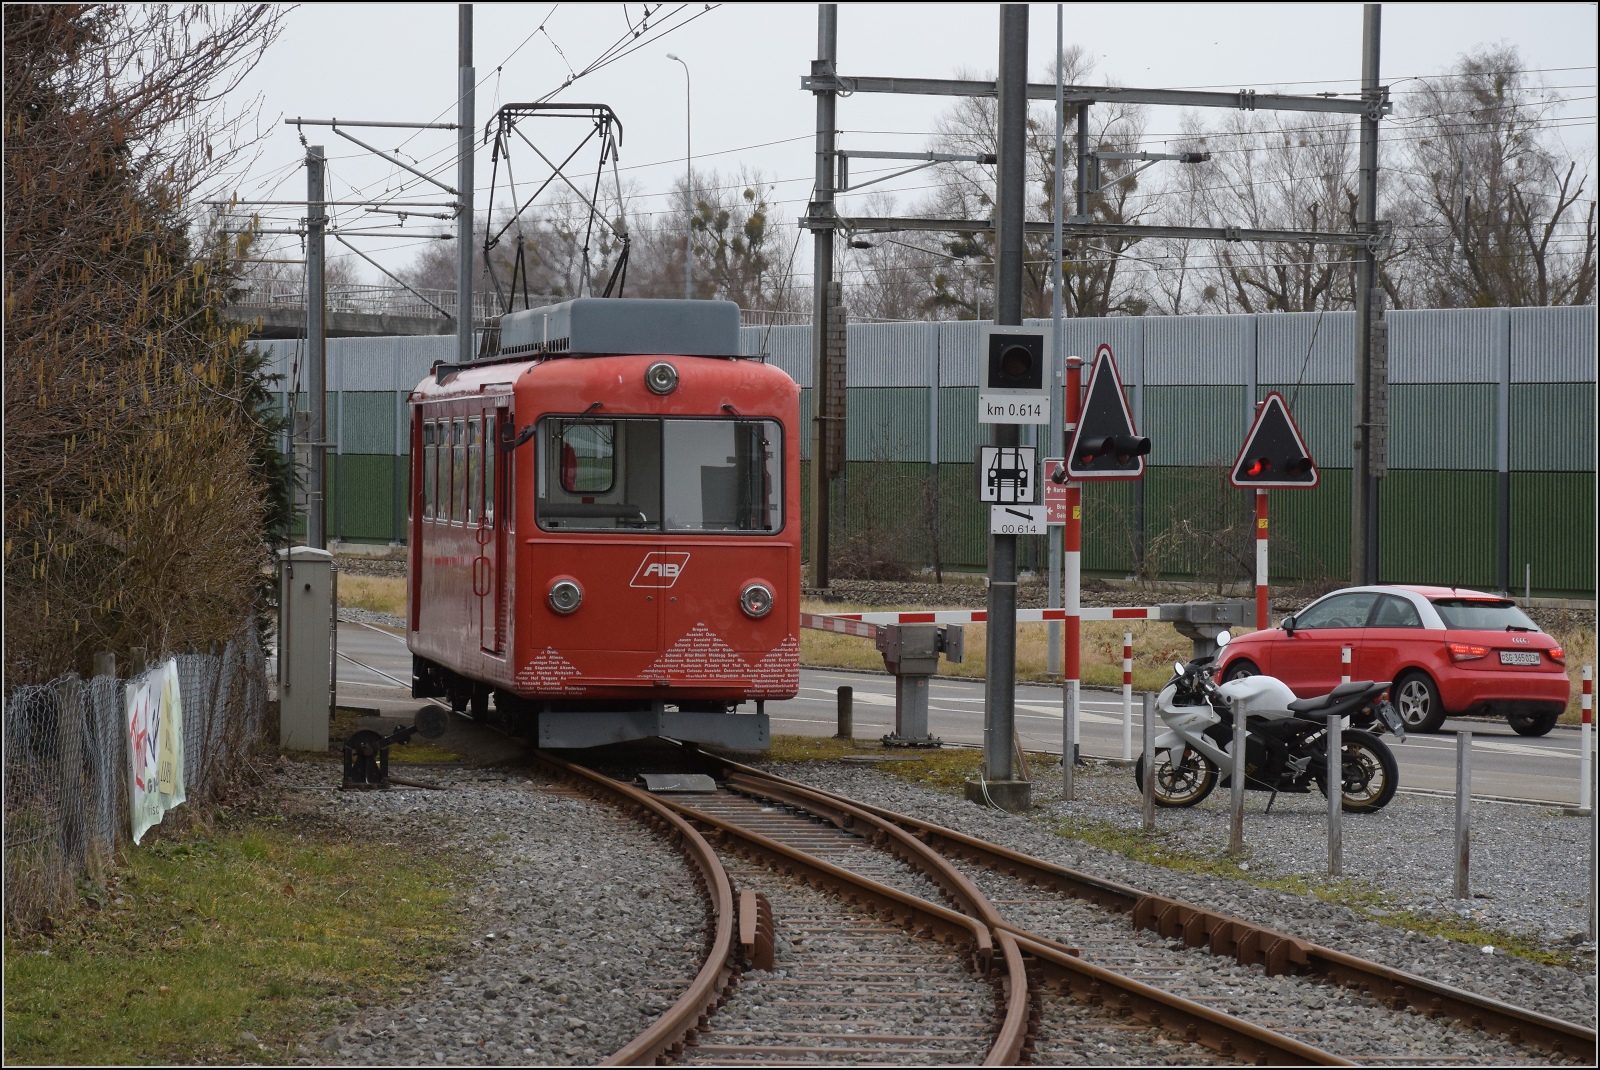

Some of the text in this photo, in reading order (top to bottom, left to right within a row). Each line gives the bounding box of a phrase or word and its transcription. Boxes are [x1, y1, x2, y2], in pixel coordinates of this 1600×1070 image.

[987, 402, 1041, 416] km 0.614
[1001, 524, 1036, 534] 00.614
[643, 563, 679, 577] AB
